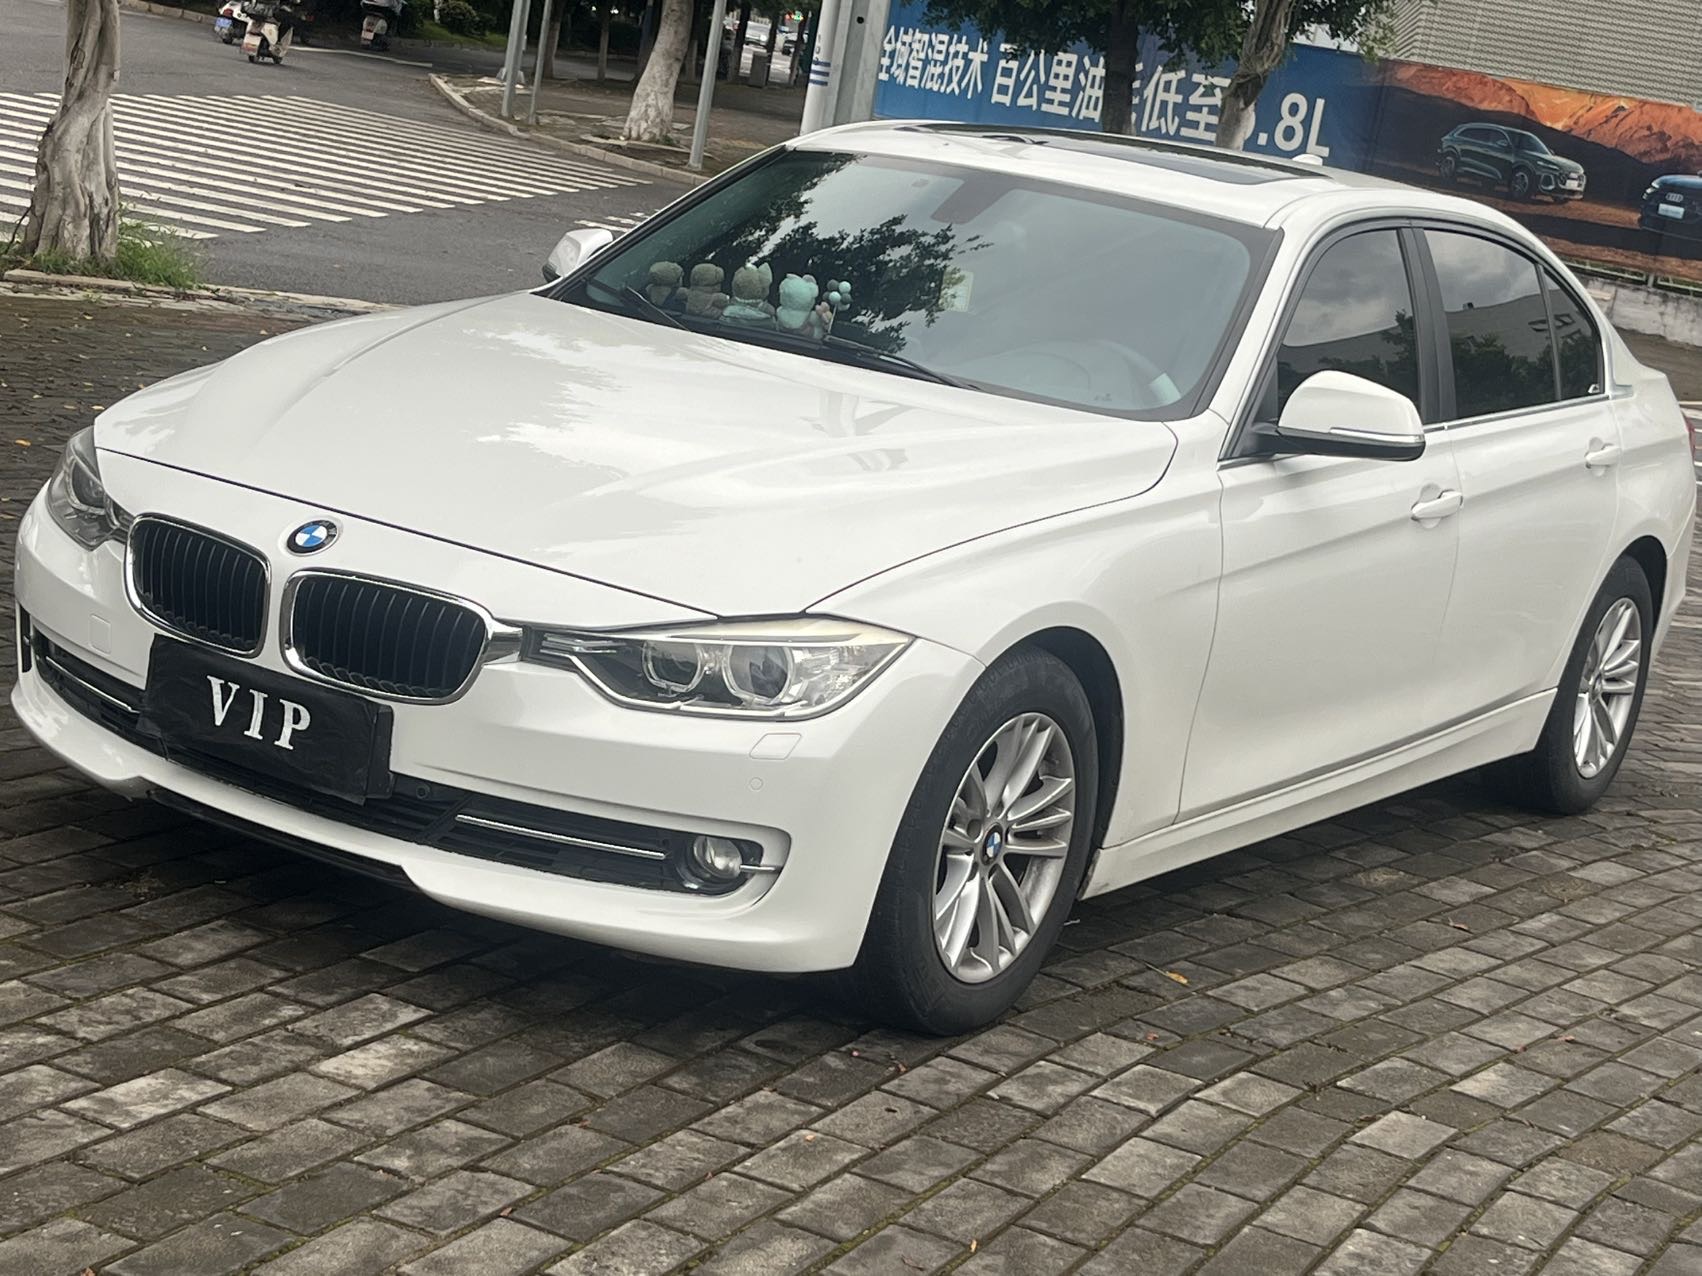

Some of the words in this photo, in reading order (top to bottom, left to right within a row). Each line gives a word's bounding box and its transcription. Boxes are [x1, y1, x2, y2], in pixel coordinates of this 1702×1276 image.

[991, 43, 1330, 158] 百公里油低至.8L
[206, 675, 311, 750] VIP
